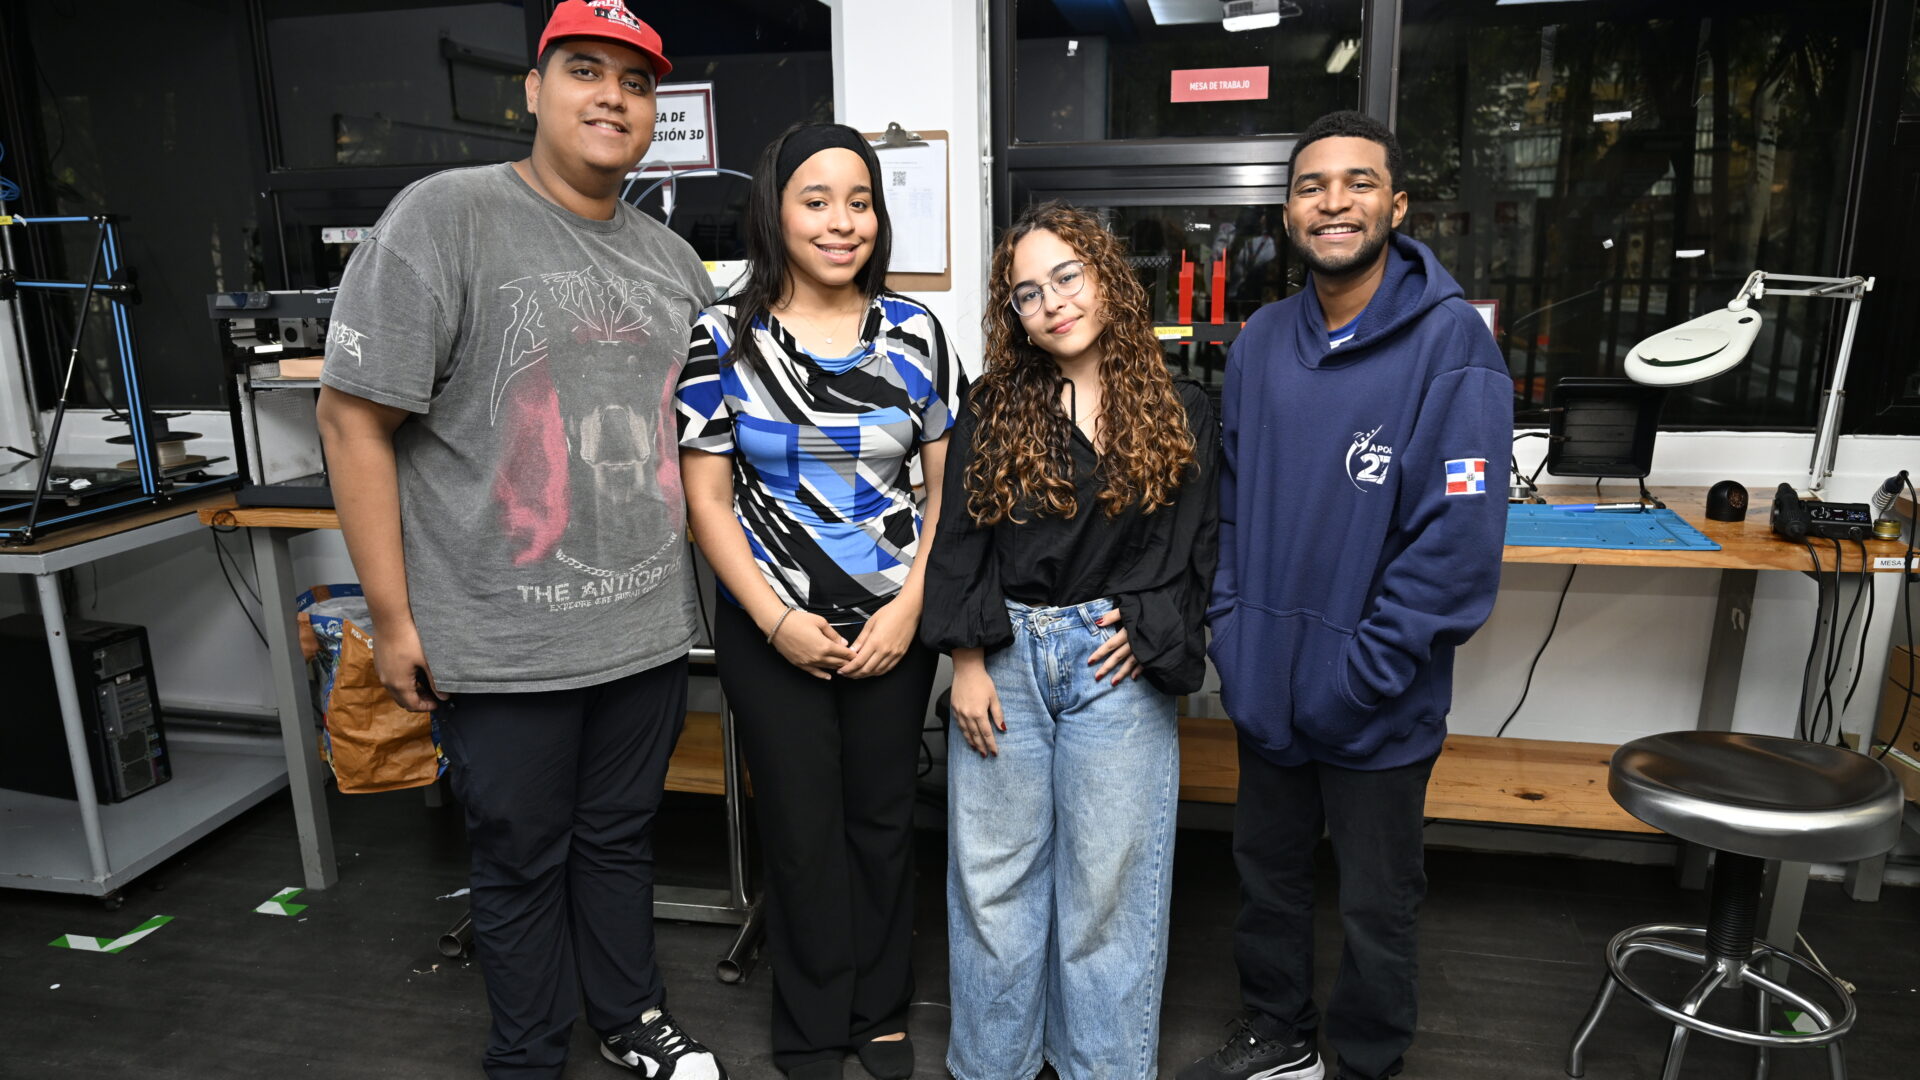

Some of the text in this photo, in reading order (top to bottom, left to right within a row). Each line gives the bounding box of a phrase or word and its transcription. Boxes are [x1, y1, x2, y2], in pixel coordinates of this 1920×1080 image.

[1189, 80, 1251, 91] MESA DE TRABAJO
[655, 112, 686, 123] EA DE
[652, 128, 705, 141] ESIÓN 3D
[1369, 444, 1393, 454] APOL
[517, 583, 570, 603] THE
